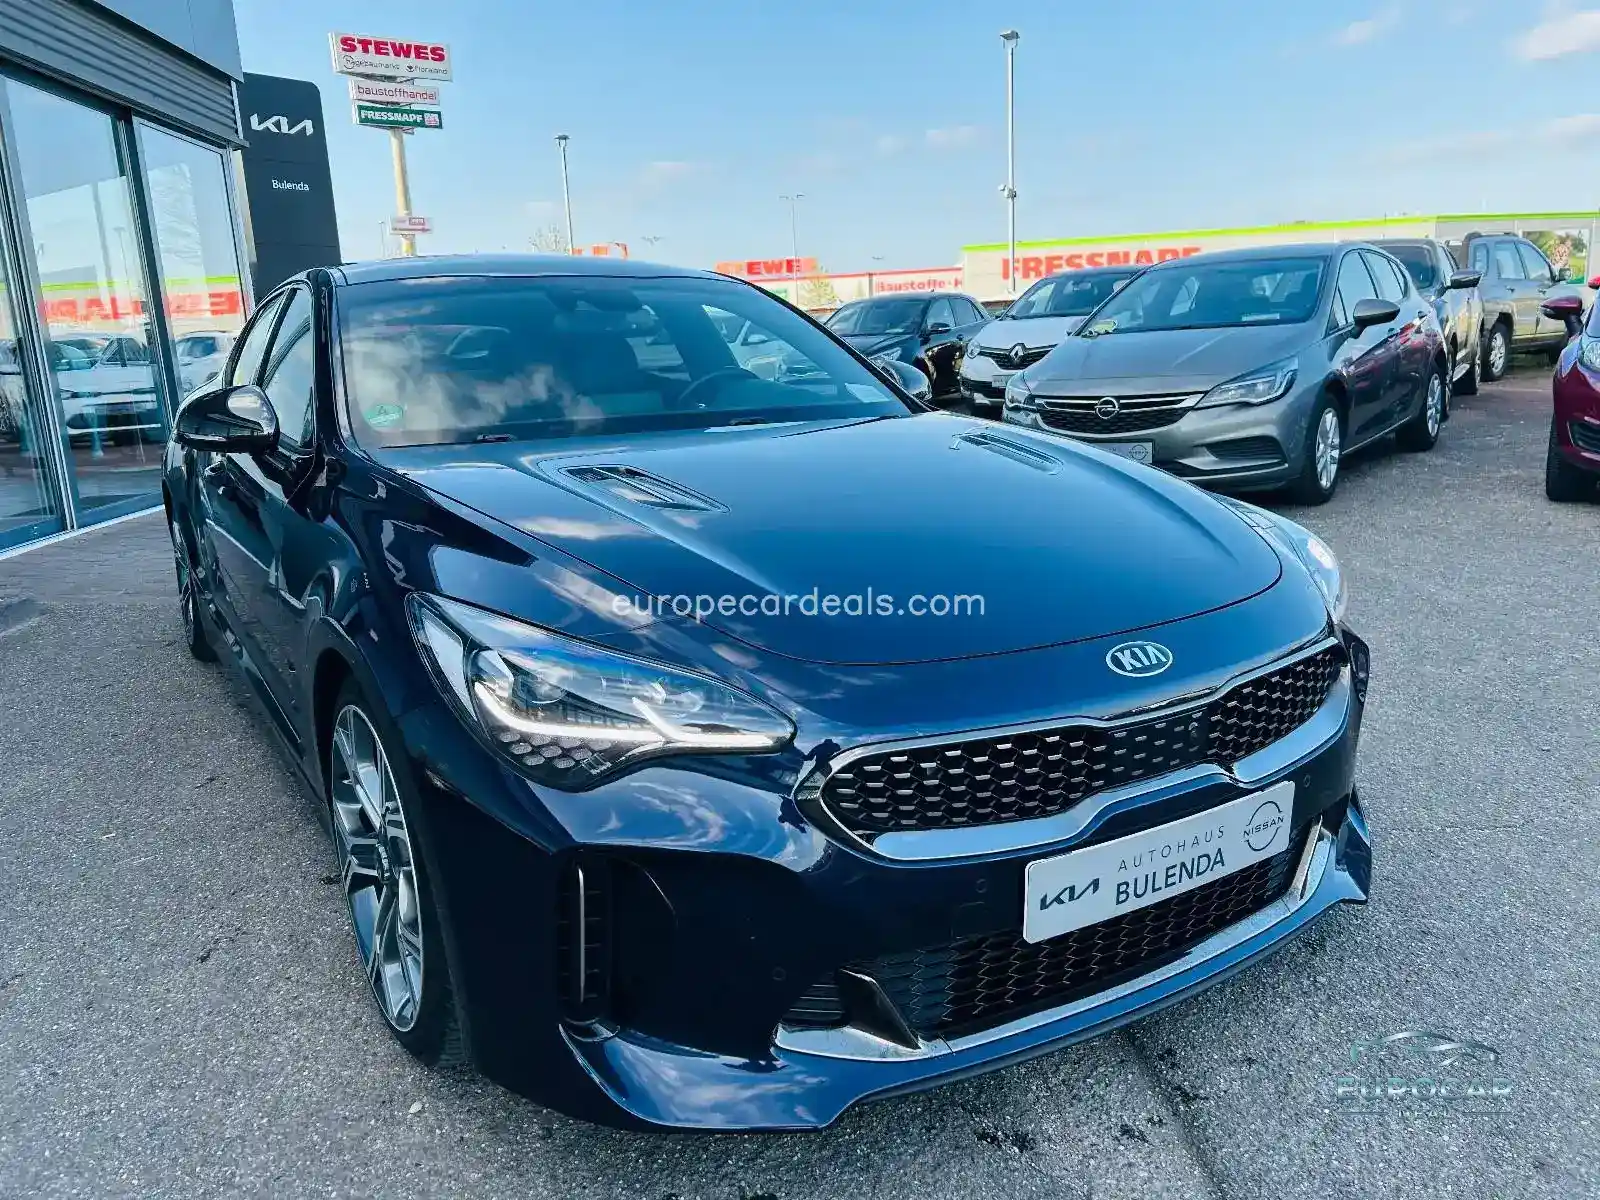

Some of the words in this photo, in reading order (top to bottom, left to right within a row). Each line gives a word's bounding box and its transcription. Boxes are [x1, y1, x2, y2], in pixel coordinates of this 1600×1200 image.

[340, 36, 445, 62] STEWES
[357, 84, 437, 100] baustoffhandel
[360, 109, 423, 123] FRESSNAPF
[272, 180, 310, 191] Bulenda
[1114, 645, 1168, 671] KIA
[1242, 815, 1285, 838] NISSAN
[1118, 825, 1225, 872] AUTOHAUS
[1115, 847, 1226, 906] BULENDA
[1040, 877, 1100, 911] KIA
